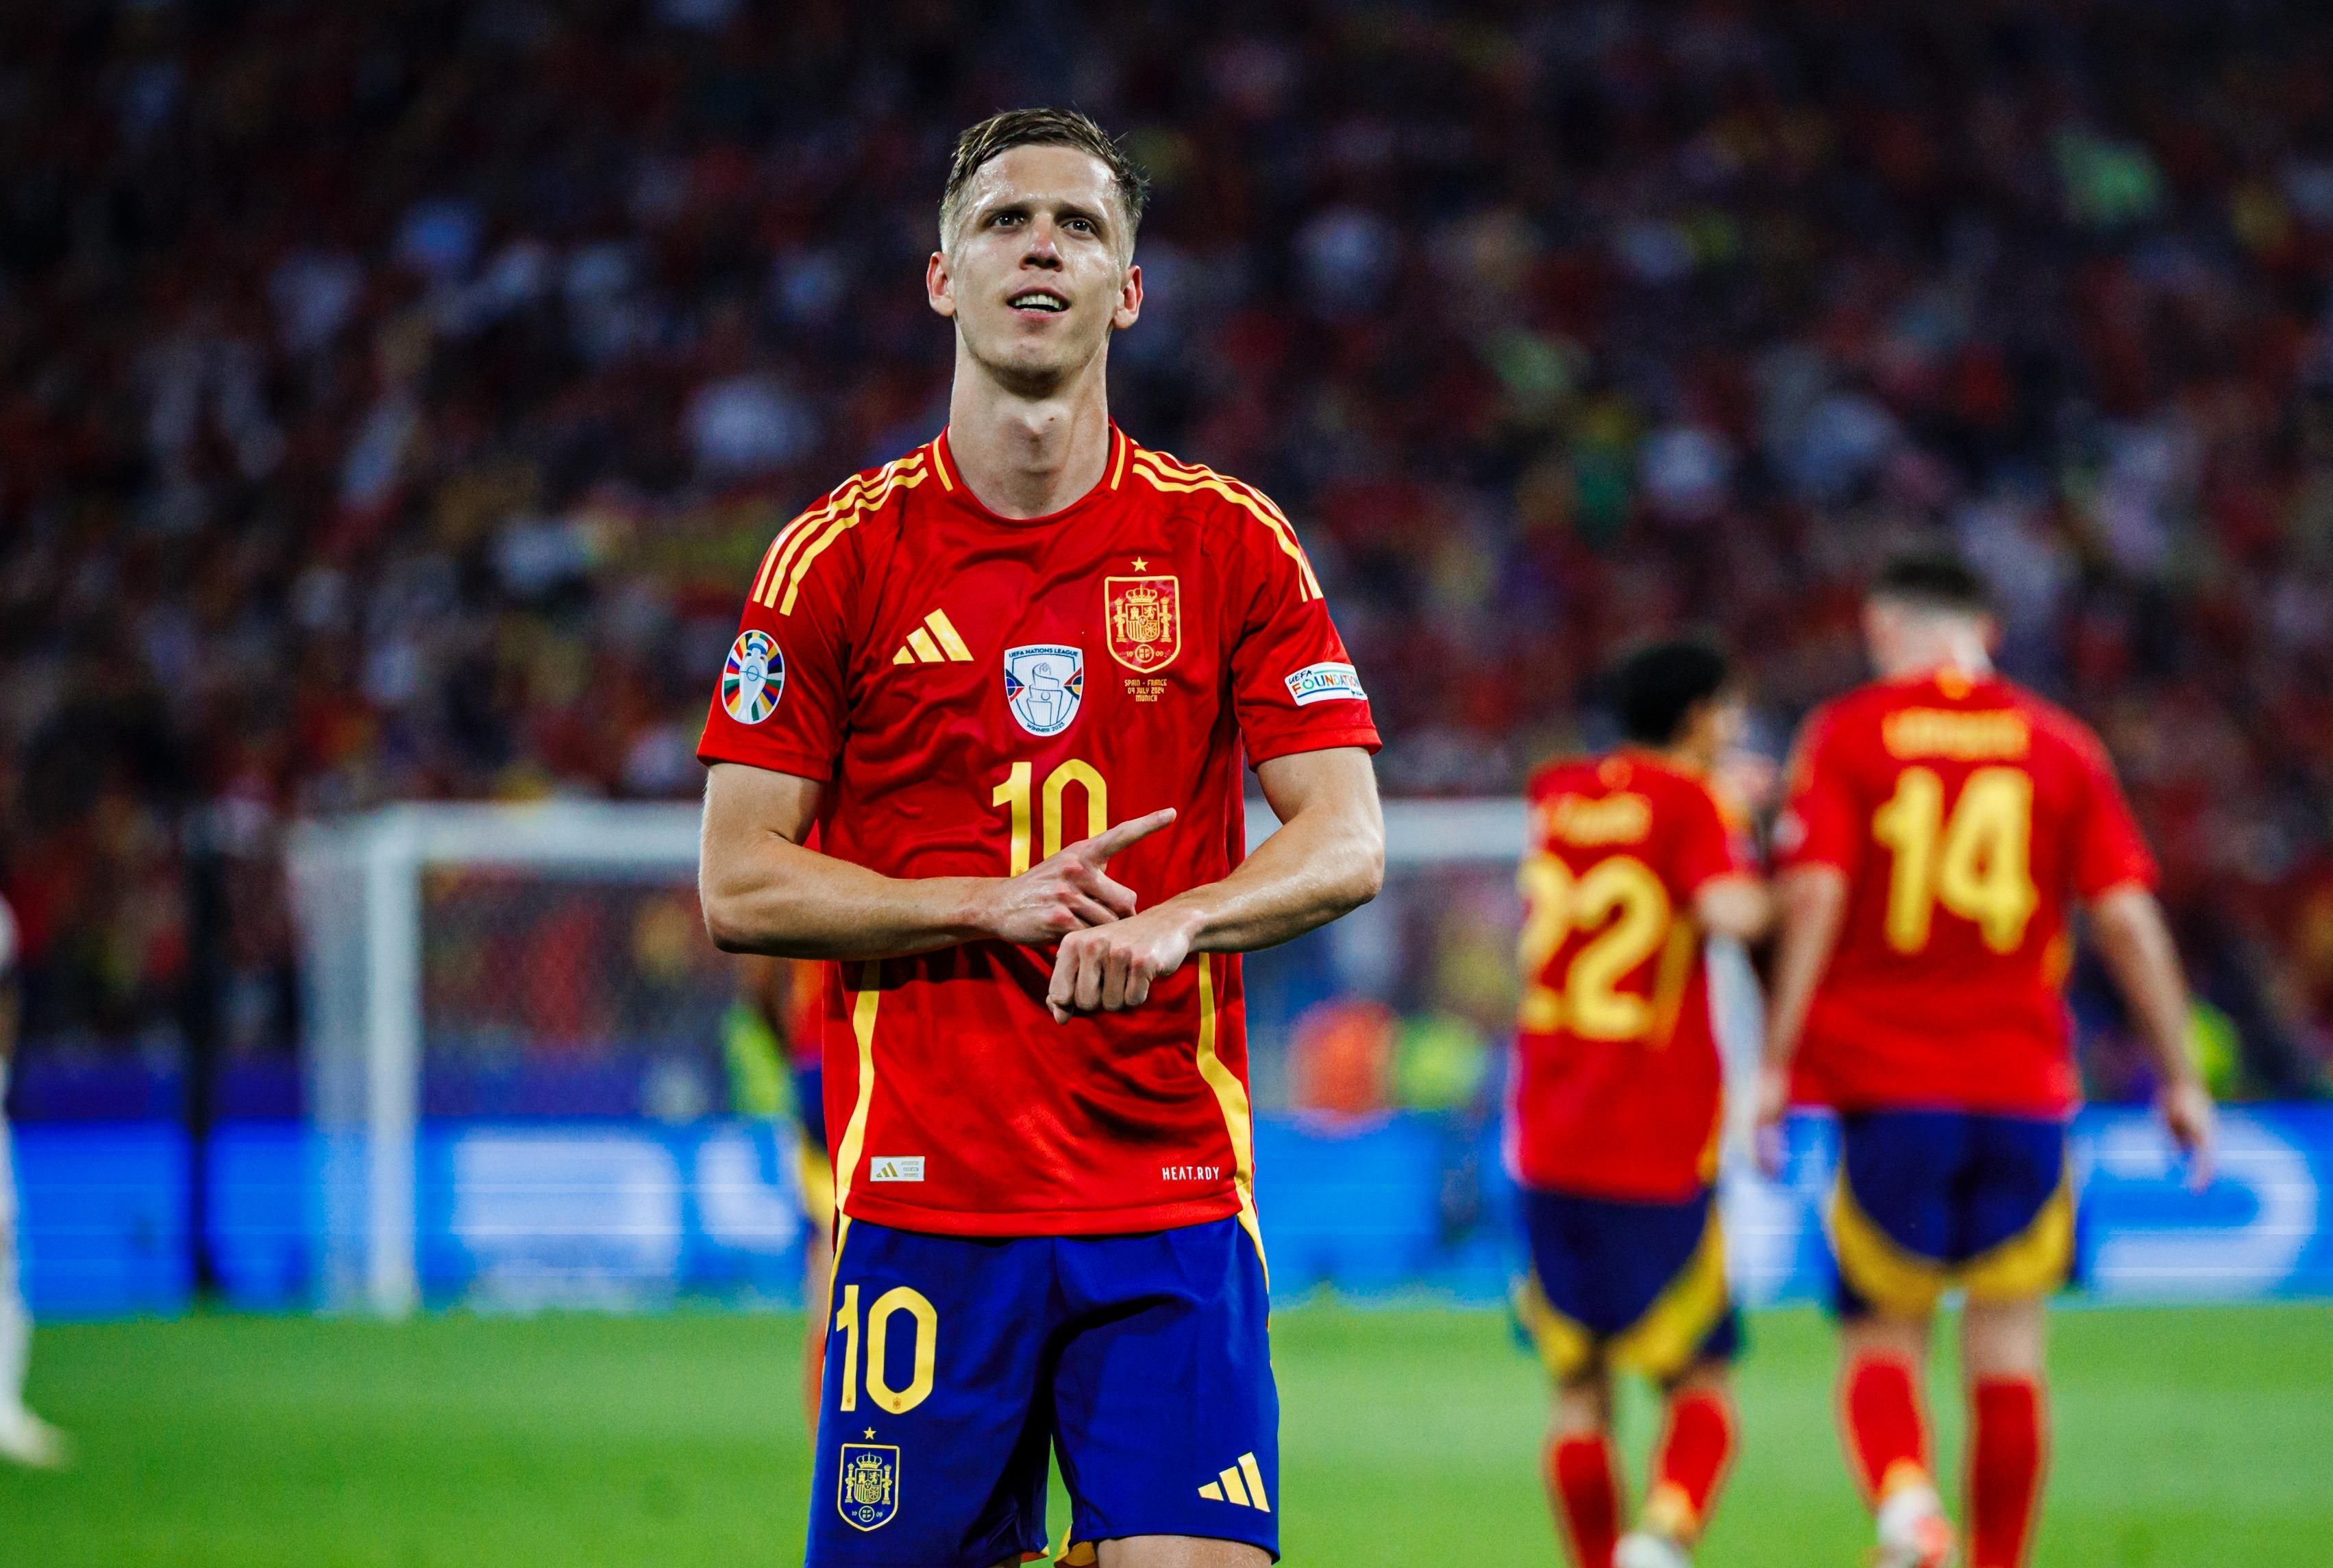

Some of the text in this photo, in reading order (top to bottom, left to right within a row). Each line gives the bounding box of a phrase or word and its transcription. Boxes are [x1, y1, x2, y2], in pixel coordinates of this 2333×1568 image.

[1289, 669, 1312, 684] UEFA
[993, 758, 1107, 878] 10
[1873, 767, 2038, 954] 14
[1518, 853, 1670, 1040] 22
[1162, 1166, 1219, 1180] HEAT.RDY
[836, 1284, 938, 1415] 10
